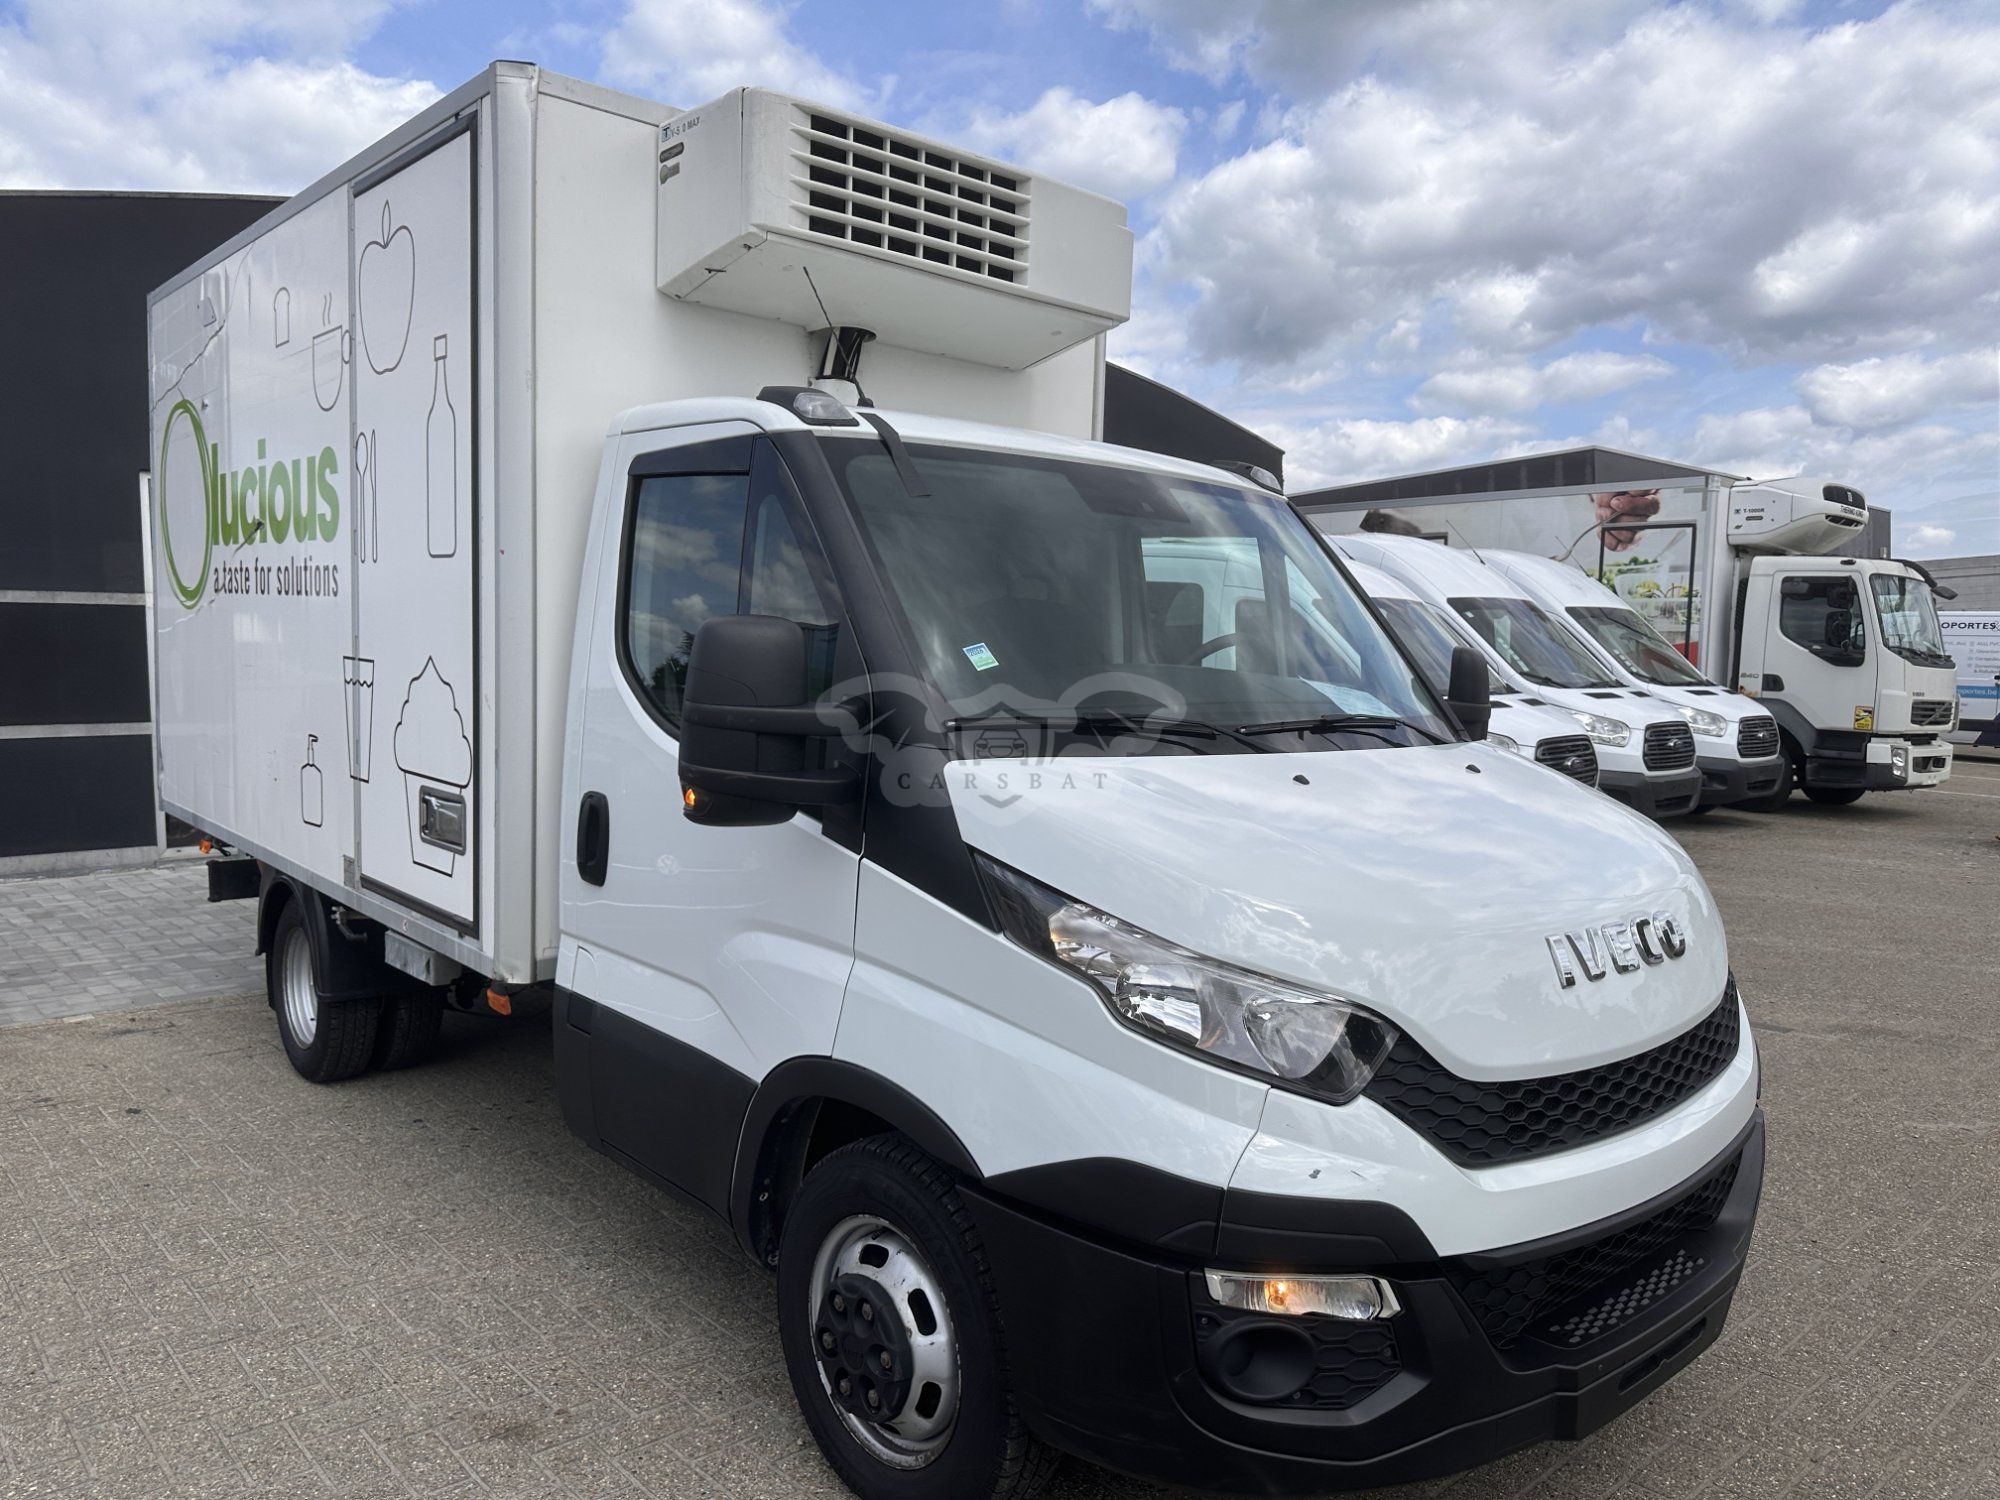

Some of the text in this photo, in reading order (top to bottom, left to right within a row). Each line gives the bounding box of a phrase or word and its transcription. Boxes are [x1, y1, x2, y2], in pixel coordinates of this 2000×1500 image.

[160, 399, 340, 609] Olucious
[213, 555, 339, 597] a taste for solutions
[1545, 910, 1686, 989] IVECO
